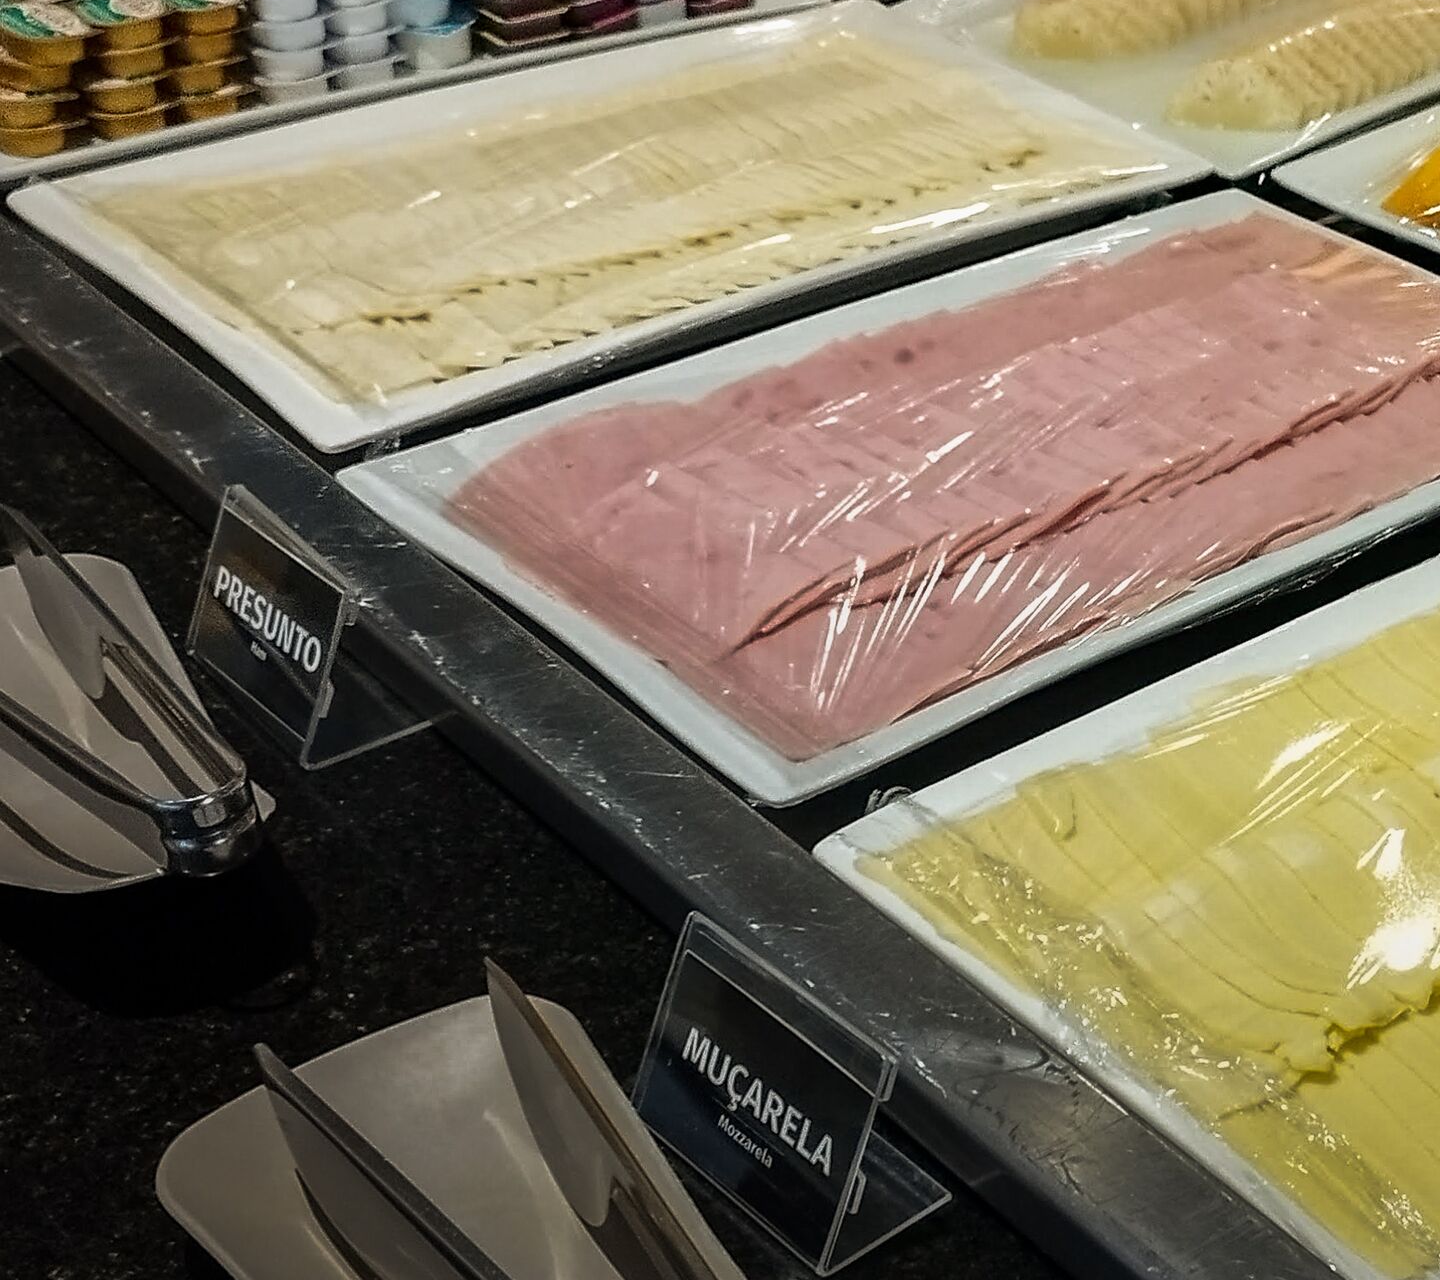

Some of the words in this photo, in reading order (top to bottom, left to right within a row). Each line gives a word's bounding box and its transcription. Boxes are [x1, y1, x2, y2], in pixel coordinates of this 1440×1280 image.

[213, 566, 322, 673] PRESUNTO
[682, 1027, 834, 1176] MUÇARELA
[717, 1114, 773, 1169] Mozzarela
